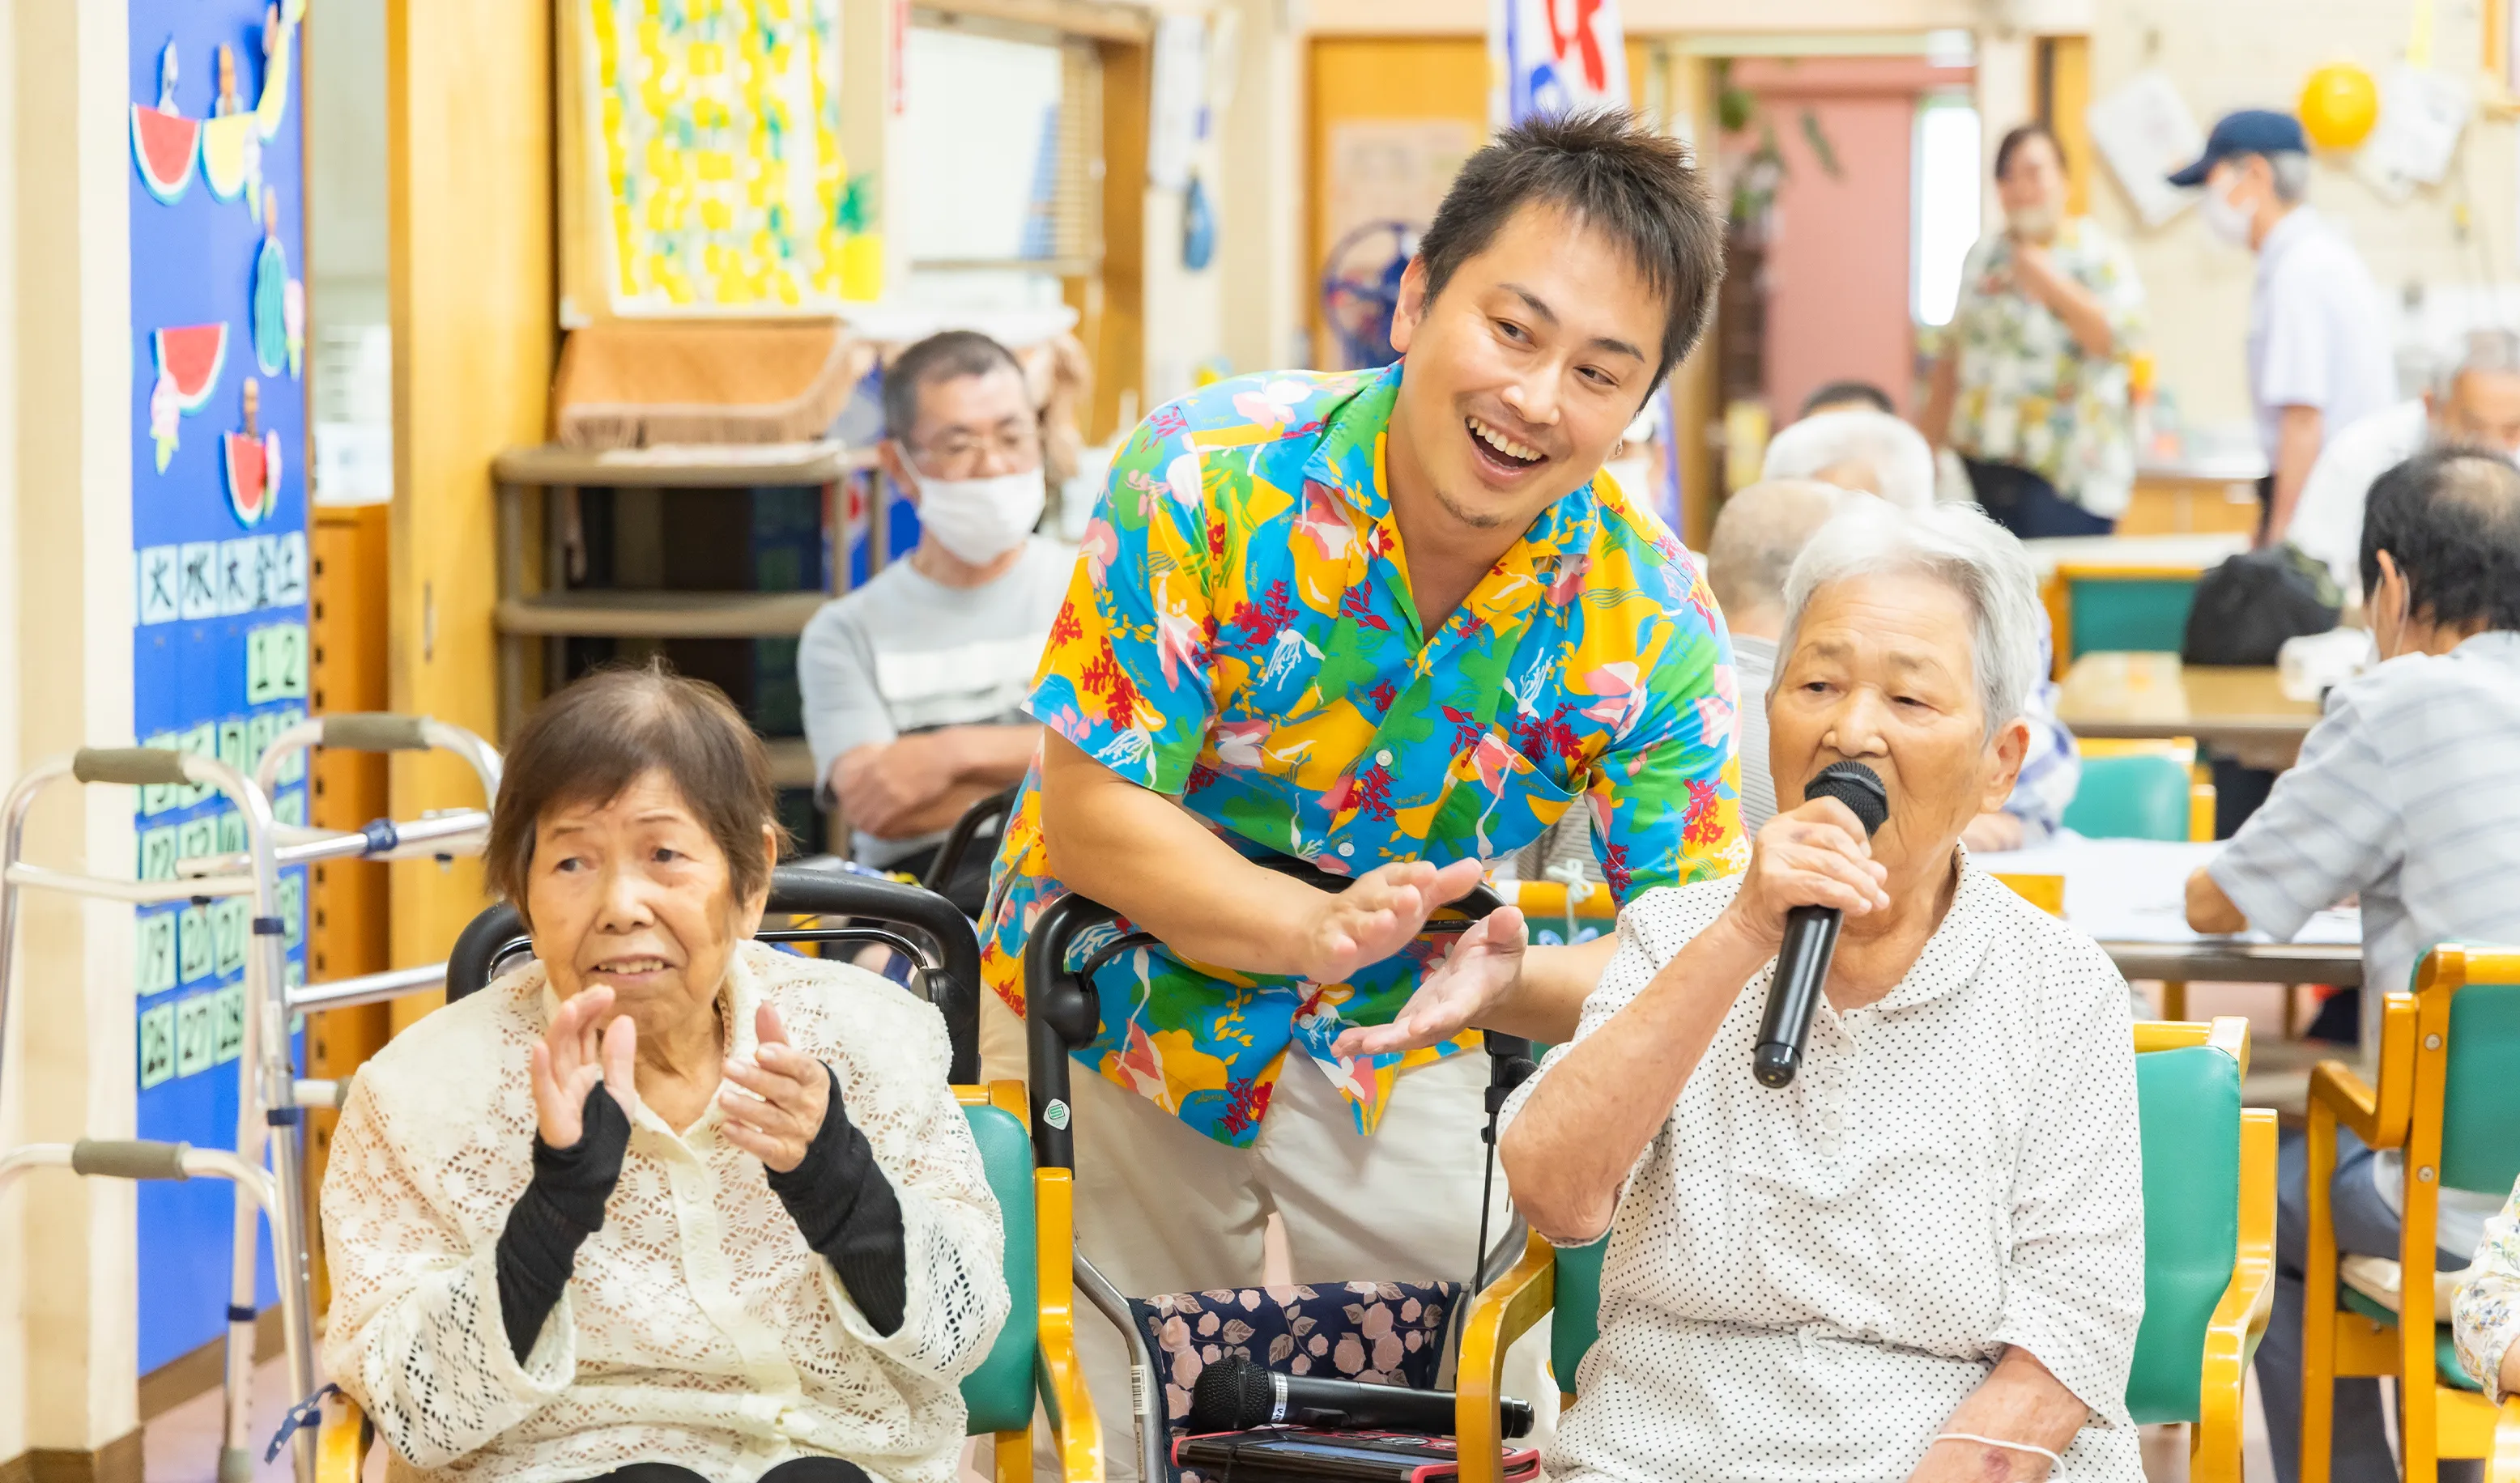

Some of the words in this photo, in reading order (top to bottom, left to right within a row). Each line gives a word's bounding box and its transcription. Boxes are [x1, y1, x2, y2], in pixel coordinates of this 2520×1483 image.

[149, 554, 172, 608] 火
[185, 552, 212, 606] 水
[256, 640, 269, 689] 1
[283, 634, 296, 687] 2
[183, 1006, 208, 1060] 27
